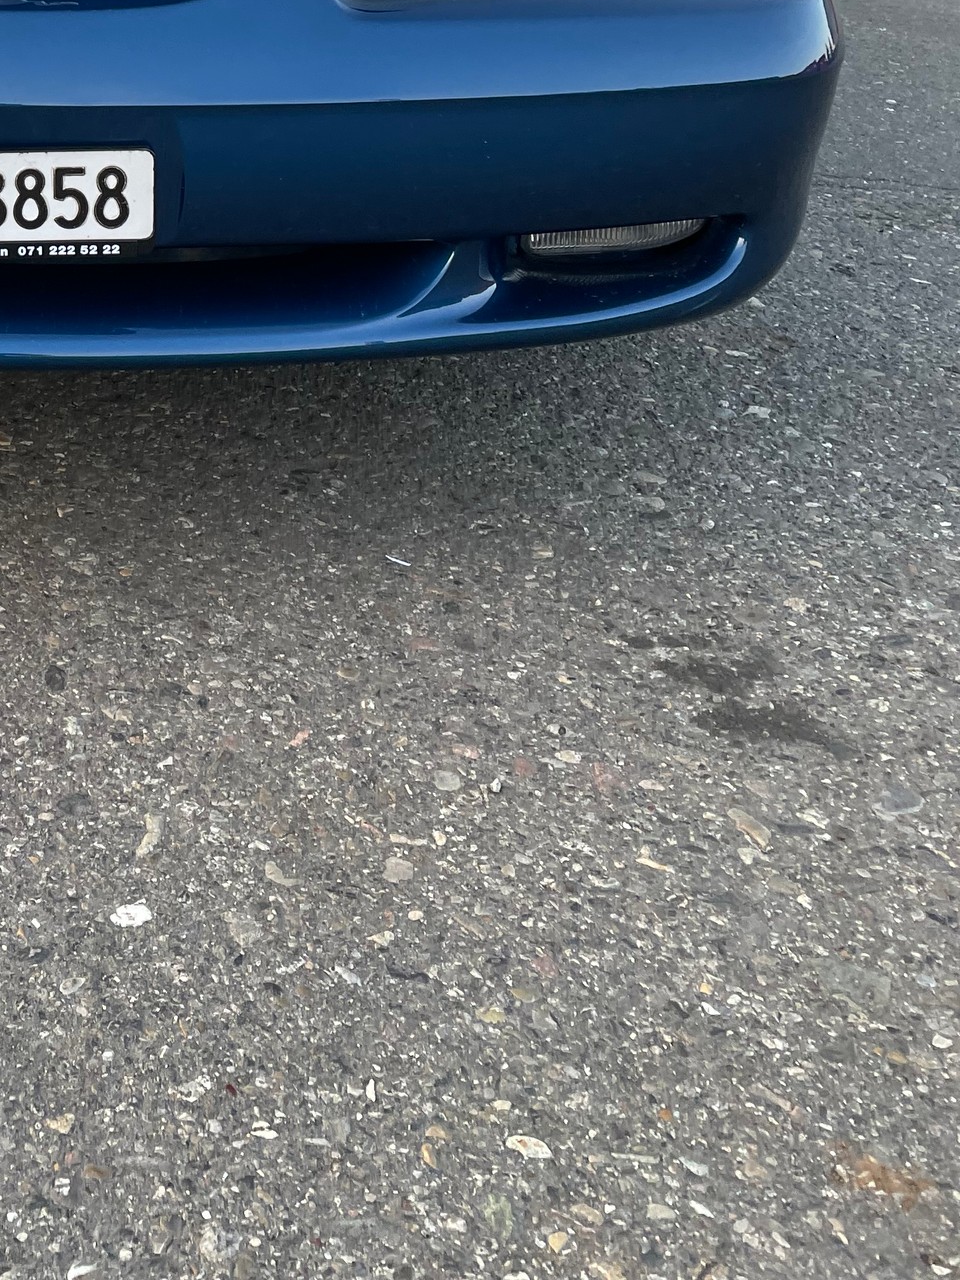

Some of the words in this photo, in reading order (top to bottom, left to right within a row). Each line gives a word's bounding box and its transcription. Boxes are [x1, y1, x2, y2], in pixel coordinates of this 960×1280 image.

[17, 245, 43, 256] 071
[48, 245, 76, 256] 222
[79, 244, 98, 255] 52
[102, 244, 121, 255] 22
